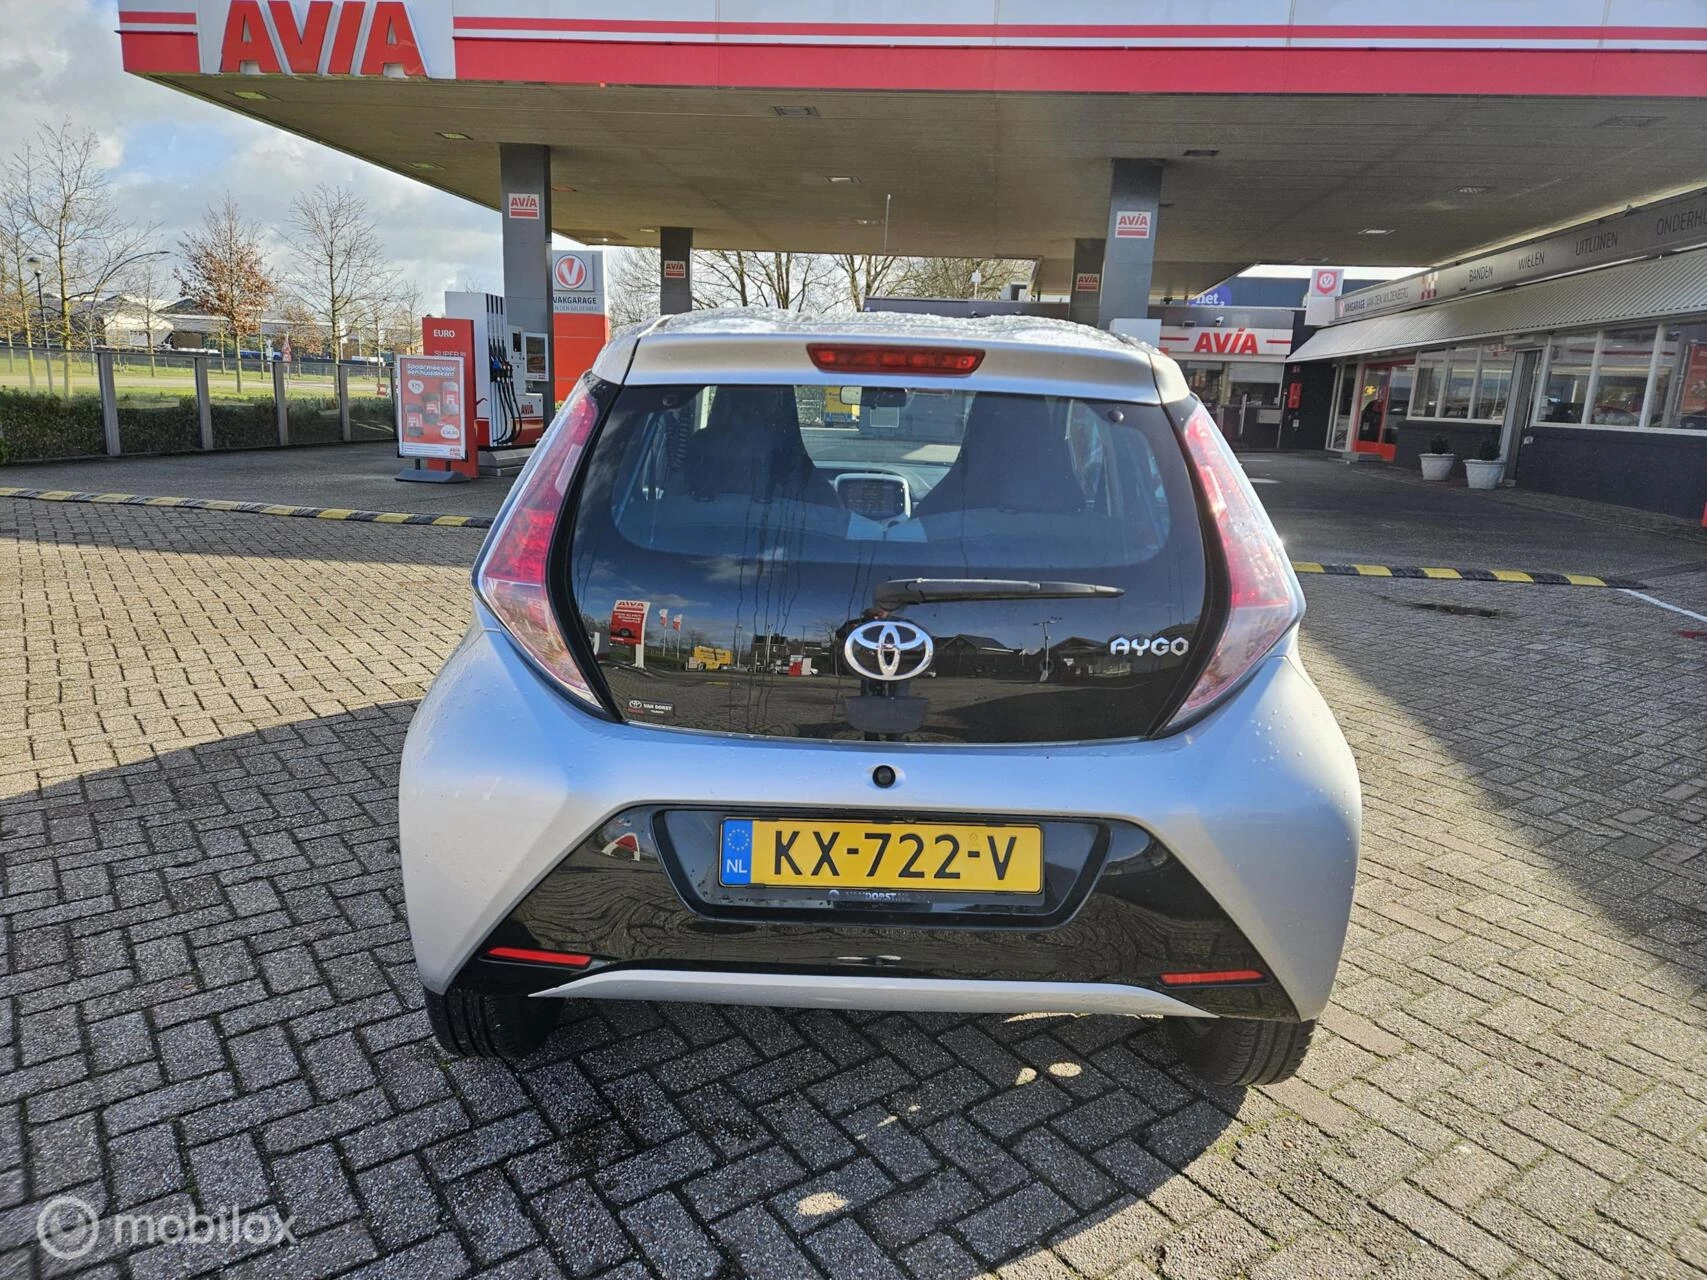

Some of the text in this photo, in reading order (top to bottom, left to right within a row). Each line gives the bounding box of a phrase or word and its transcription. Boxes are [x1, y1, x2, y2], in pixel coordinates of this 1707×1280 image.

[220, 0, 429, 77] AVIA
[1469, 265, 1493, 282] BANDEN
[1518, 250, 1545, 270] WIELEN
[552, 296, 597, 304] VAKGARAGE
[433, 329, 456, 338] EURO
[1110, 636, 1189, 656] AYGO
[726, 830, 1017, 881] NL KX-722-V
